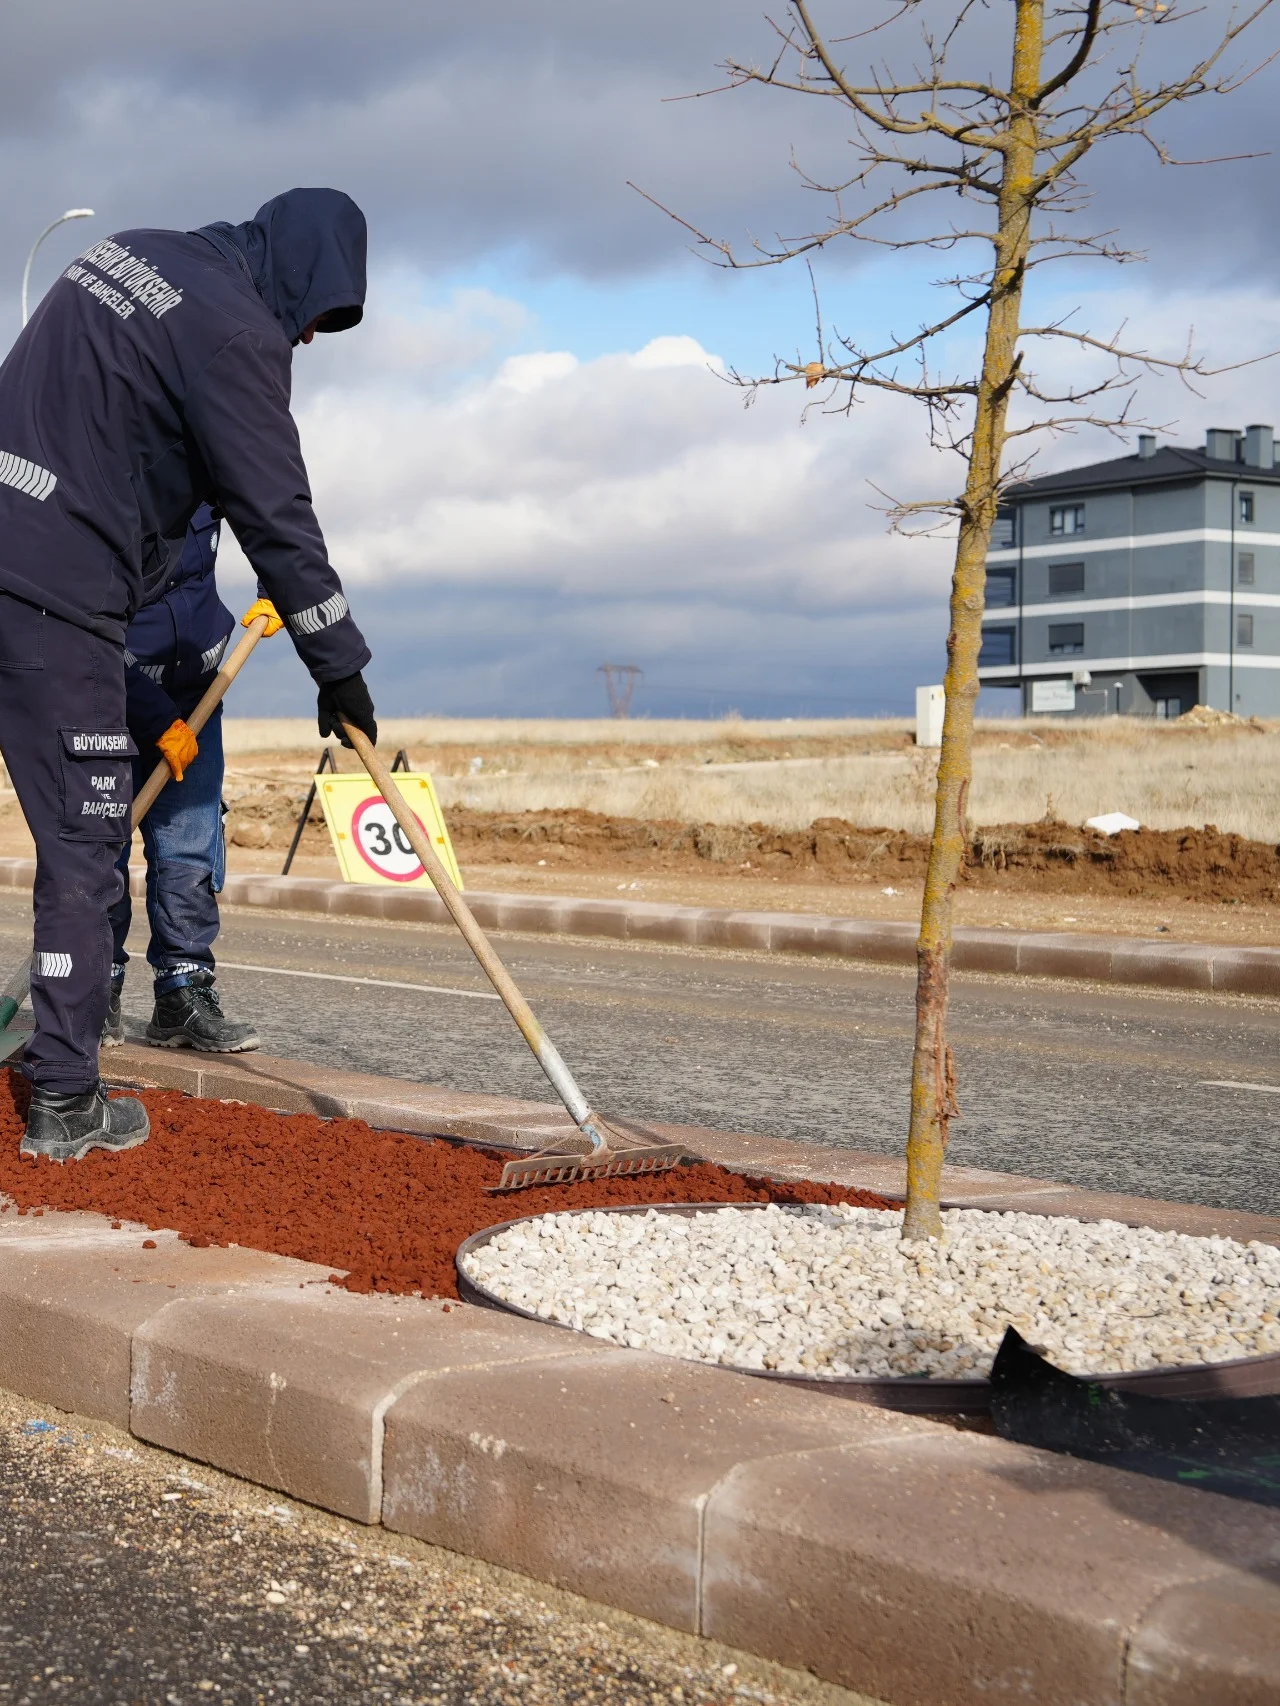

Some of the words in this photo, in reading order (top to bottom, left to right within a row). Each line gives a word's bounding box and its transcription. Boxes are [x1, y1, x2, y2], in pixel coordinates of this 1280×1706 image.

[78, 272, 98, 287] VE
[107, 256, 184, 320] BÜYÜKŞEHİR
[87, 280, 136, 320] BAHÇELER
[73, 733, 128, 754] BÜYÜKŞEHİR
[91, 775, 117, 791] PARK
[81, 801, 128, 819] BAHÇELER
[364, 822, 416, 856] 30
